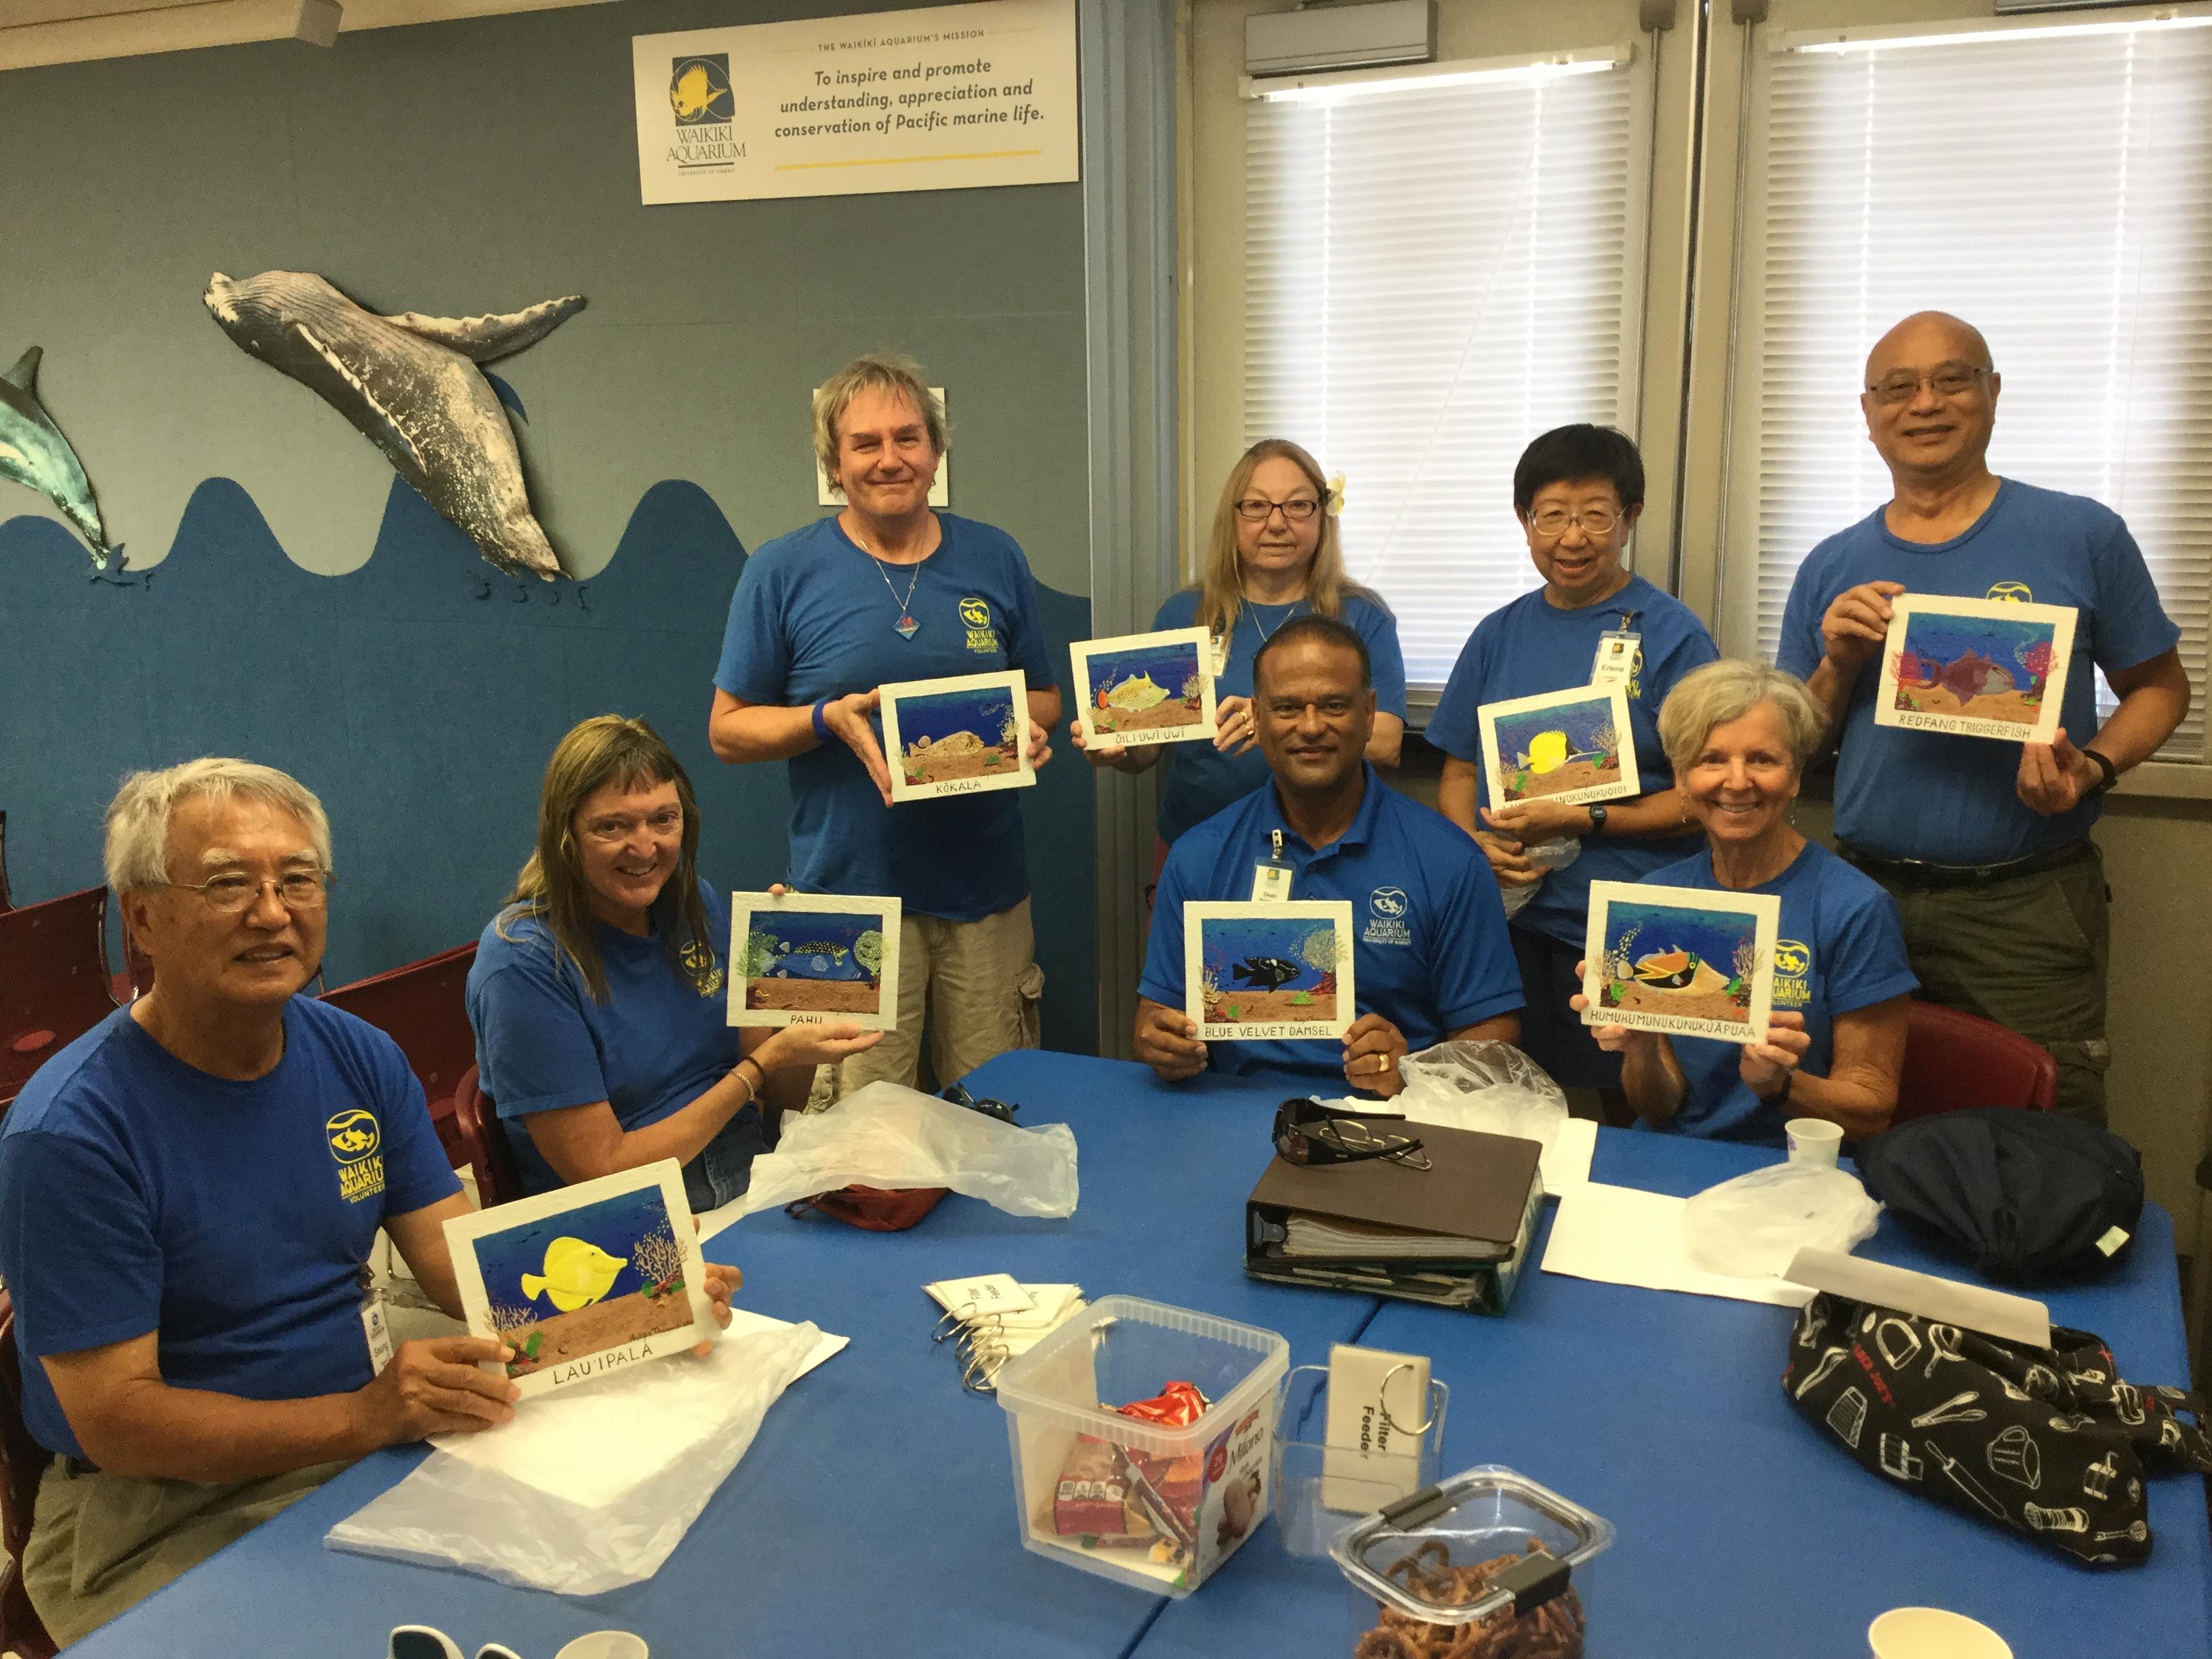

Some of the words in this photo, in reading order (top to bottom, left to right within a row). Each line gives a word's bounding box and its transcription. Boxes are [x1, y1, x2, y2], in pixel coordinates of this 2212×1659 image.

[818, 43, 836, 52] THE
[943, 30, 984, 41] MISSION
[815, 70, 831, 86] To
[836, 67, 887, 87] inspire
[893, 62, 921, 80] and
[926, 58, 991, 81] promote
[781, 91, 893, 113] understanding,
[899, 84, 997, 107] appreciation
[1002, 78, 1033, 96] and
[775, 118, 870, 138] conservation
[876, 114, 892, 134] of
[896, 111, 948, 131] Pacific
[953, 108, 1008, 125] marine
[1013, 104, 1044, 125] life.
[676, 125, 733, 144] WAIKIKI
[666, 142, 746, 164] AQUARIUM
[1899, 714, 1957, 731] REDFANG
[1961, 721, 2031, 739] TRIGGERFISH
[1364, 926, 1411, 939] AQUARIUM
[1370, 919, 1406, 929] WAIKIKI
[1774, 977, 1807, 990] AIKIKI
[1774, 987, 1811, 1001] UARIUM
[1205, 1027, 1233, 1037] BLUE
[1240, 1027, 1285, 1037] VELVET
[1289, 1026, 1332, 1036] DAMSEL
[340, 1168, 384, 1197] AQUARIU
[1360, 1405, 1375, 1460] Feeder
[1227, 1427, 1264, 1475] Milano
